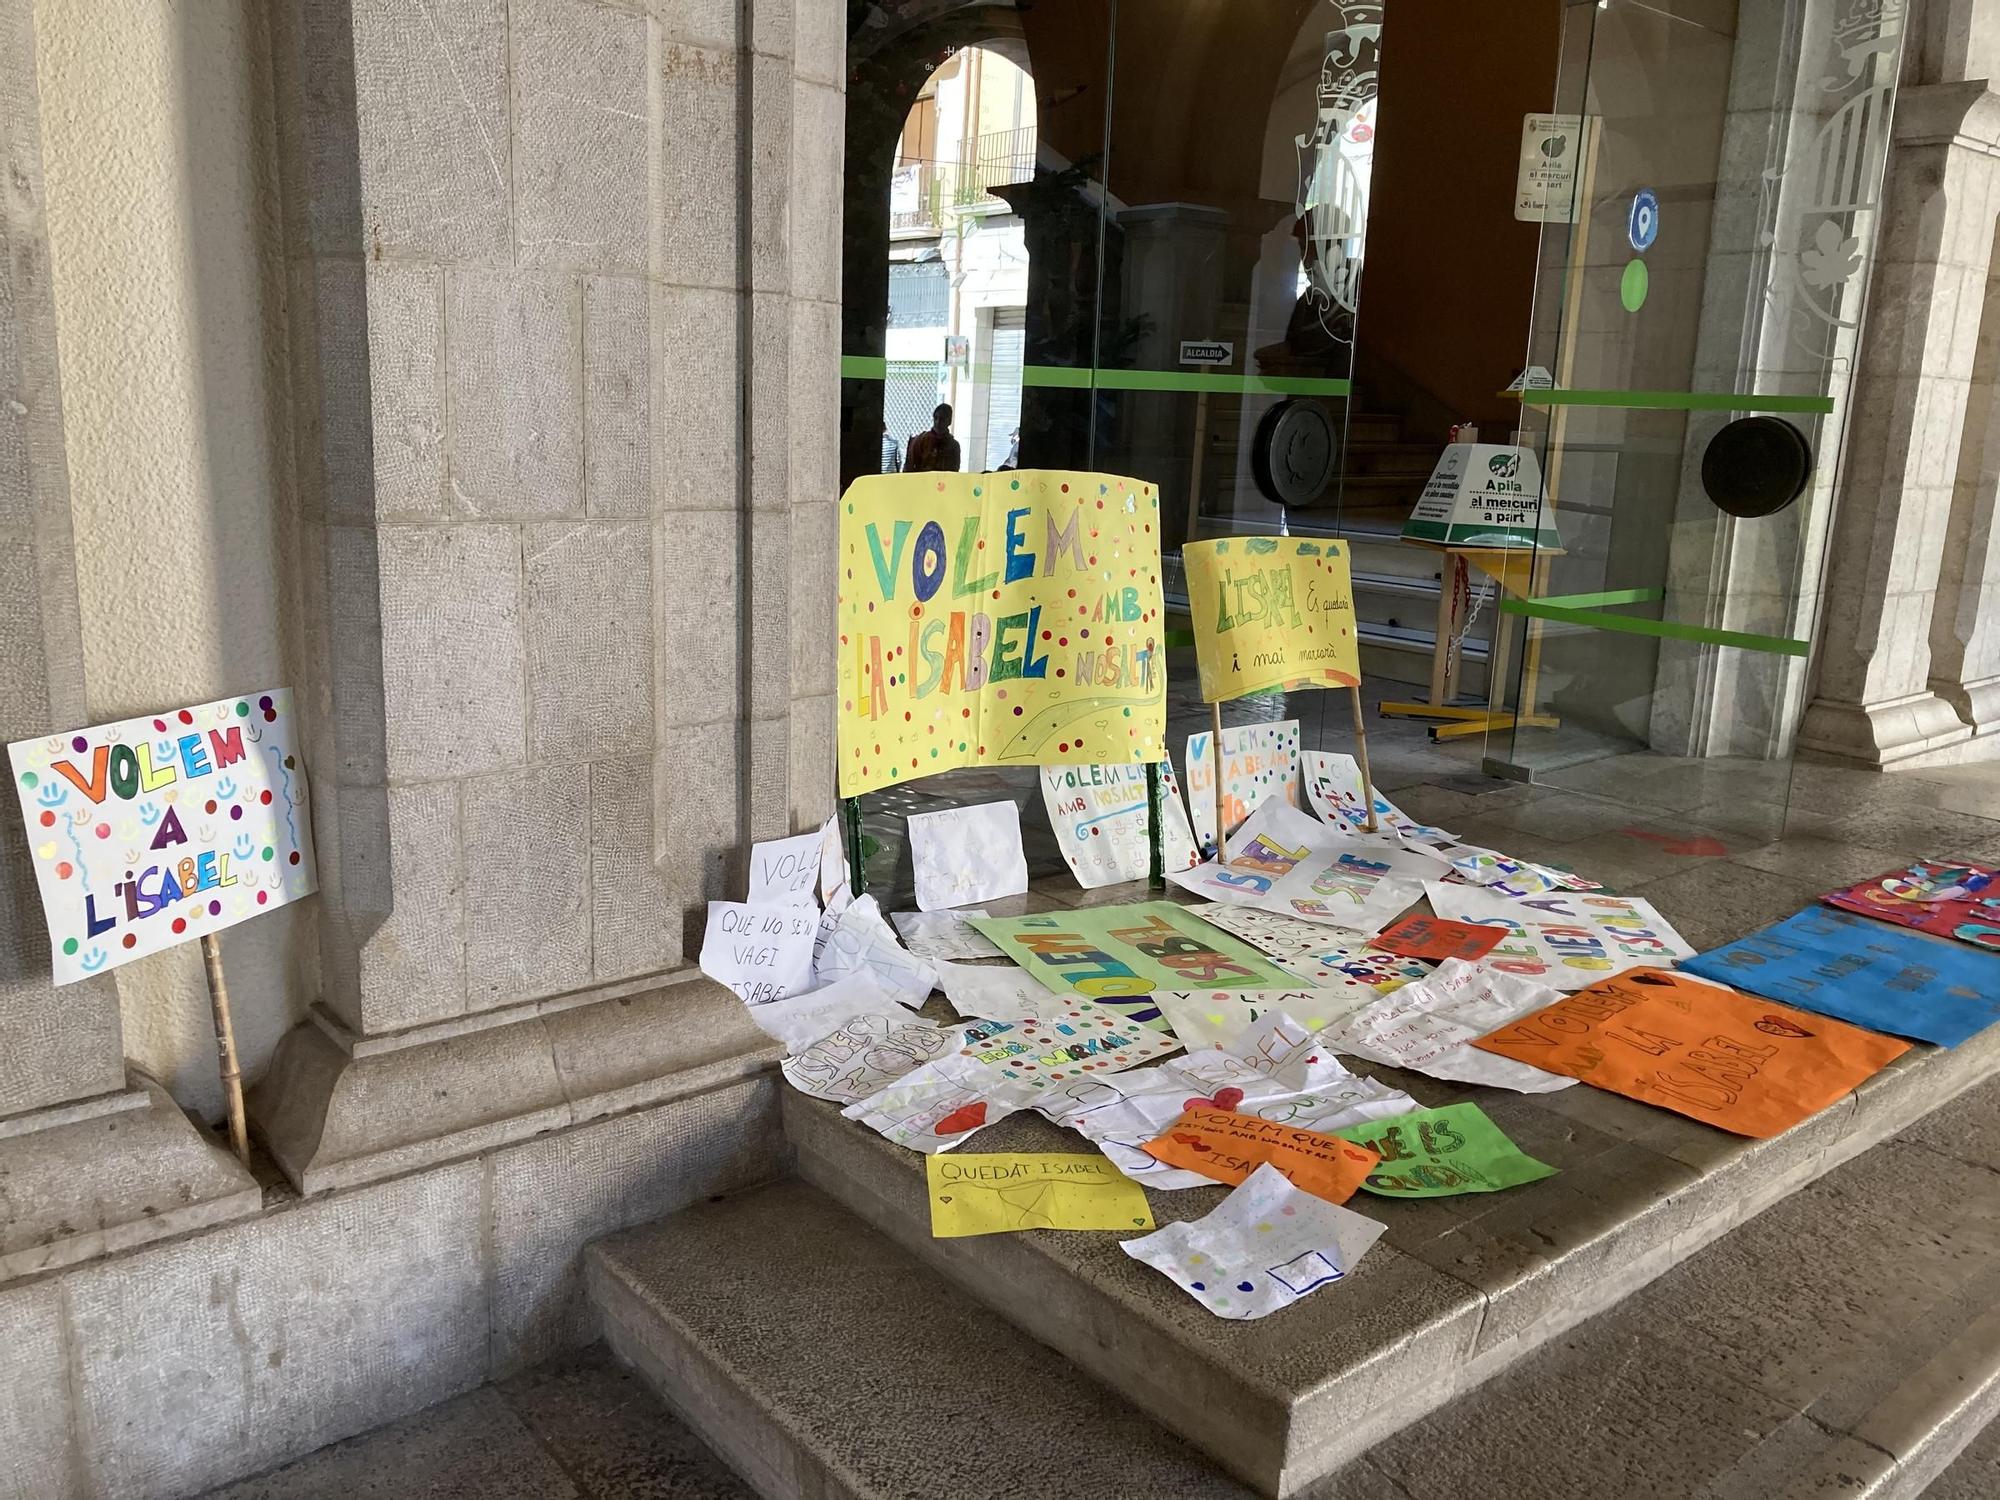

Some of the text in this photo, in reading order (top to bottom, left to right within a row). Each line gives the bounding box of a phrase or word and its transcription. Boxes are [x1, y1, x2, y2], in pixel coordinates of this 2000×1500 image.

[1186, 349, 1223, 358] ALCALDIA
[1485, 479, 1522, 492] A pila
[1471, 495, 1537, 511] el mercuri
[1484, 510, 1525, 524] a part
[864, 507, 1088, 602] VOLEM
[1091, 587, 1143, 624] AMB
[1231, 653, 1241, 673] i
[1253, 647, 1285, 668] mai
[856, 633, 889, 721] LA
[50, 726, 247, 805] VOLEM
[1048, 763, 1121, 792] VOLEM
[1057, 796, 1087, 816] AMB
[149, 804, 188, 850] A
[722, 908, 756, 937] QUE
[760, 917, 784, 936] NO
[733, 944, 779, 968] VAGI
[731, 981, 789, 1003] ISABE
[1604, 1024, 1684, 1057] LA
[1193, 1111, 1336, 1151] VOLEM QUE
[1040, 1161, 1108, 1176] ISABEL
